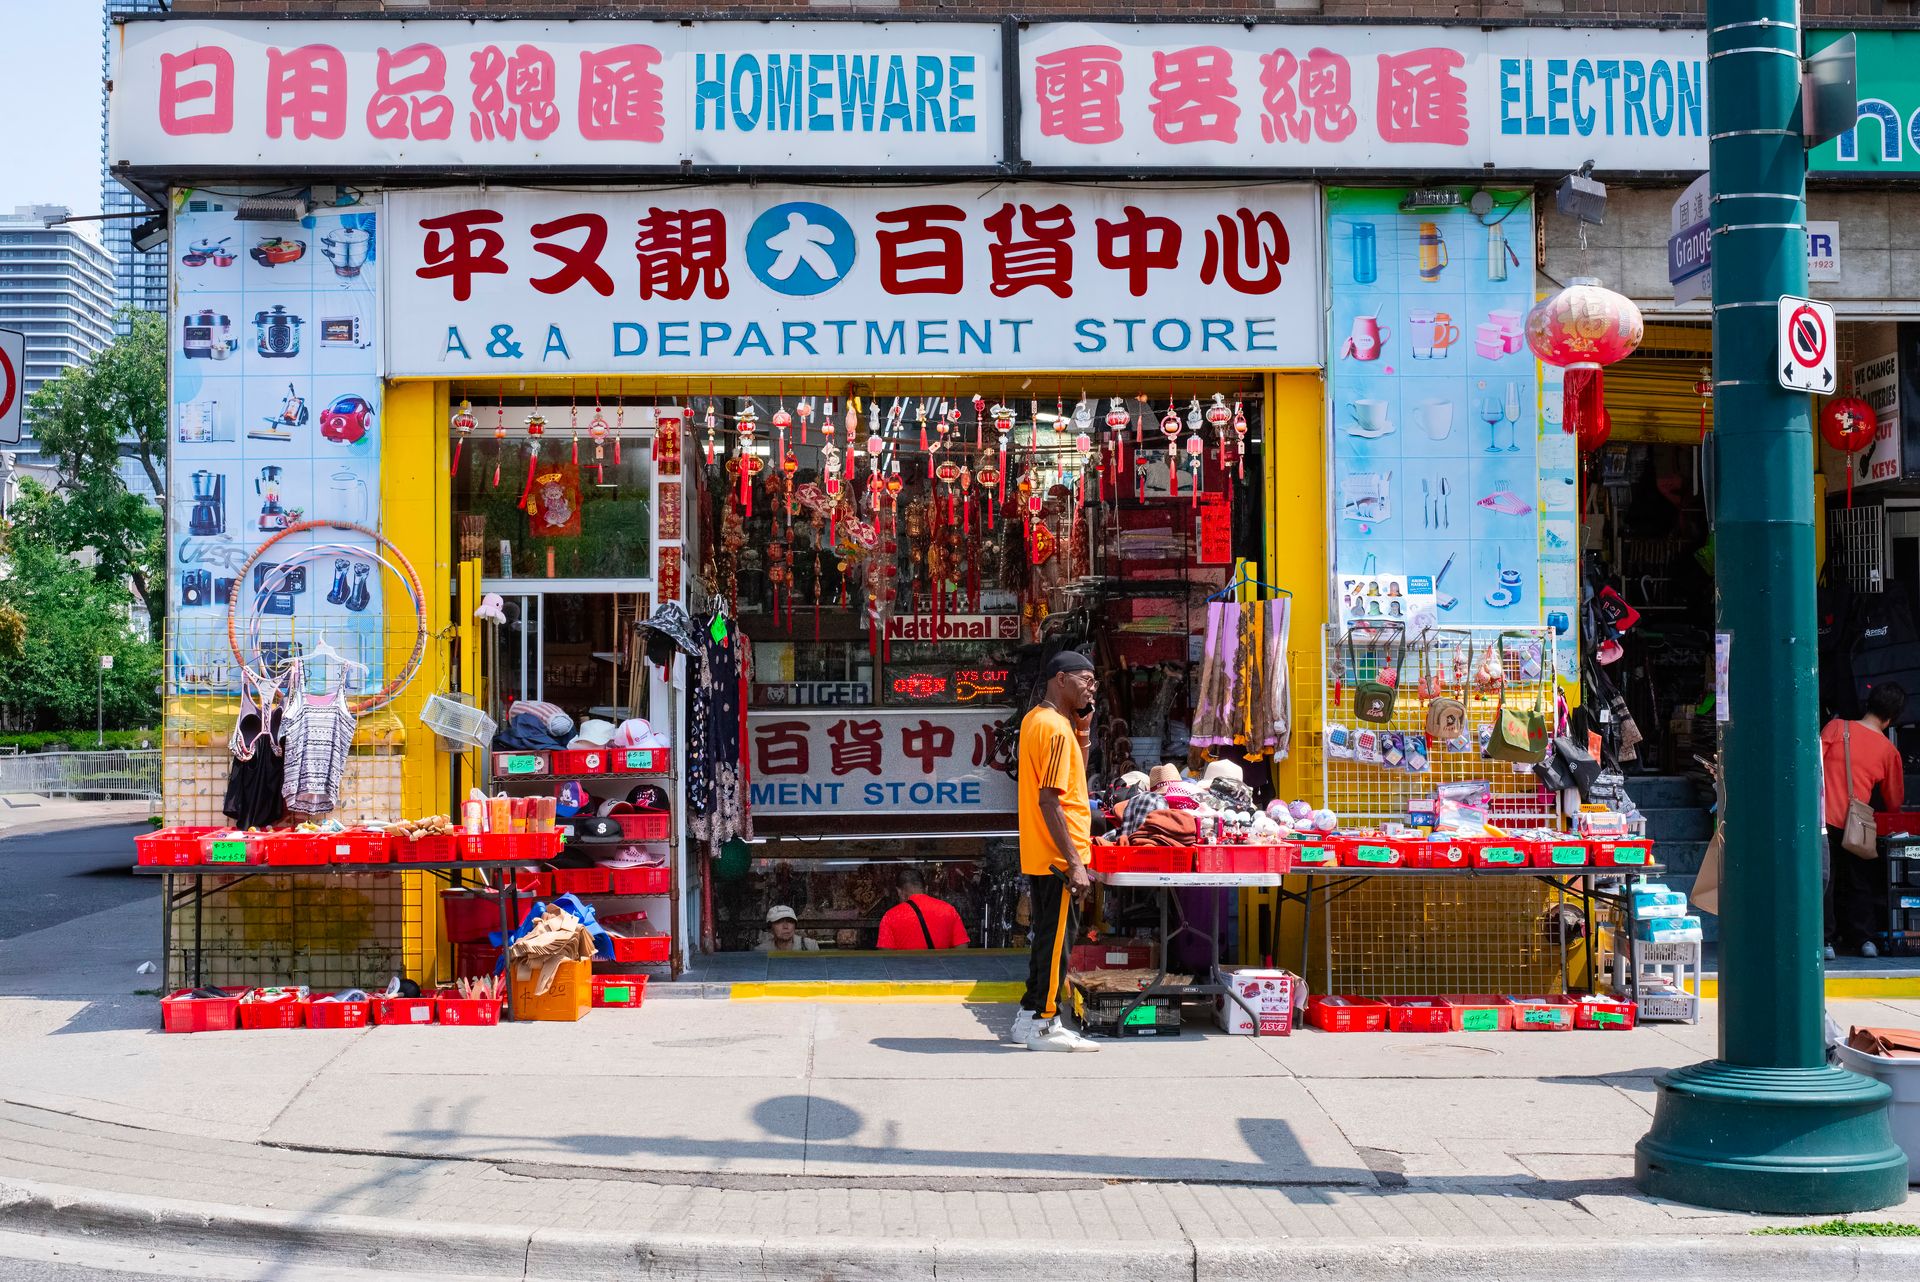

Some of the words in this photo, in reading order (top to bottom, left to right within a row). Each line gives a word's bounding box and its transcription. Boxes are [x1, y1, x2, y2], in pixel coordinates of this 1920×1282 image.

[158, 43, 665, 144] 日用品總匯
[696, 53, 975, 133] HOMEWARE
[1036, 46, 1469, 146] 電器總匯
[1500, 58, 1702, 137] ELECTRON
[1837, 97, 1920, 162] n
[416, 206, 730, 300] 平又靚
[876, 202, 1290, 299] 百貨中心
[1675, 227, 1711, 268] Grange
[1807, 234, 1832, 257] R
[1814, 261, 1834, 269] 1923
[613, 319, 1032, 357] DEPARTMENT
[1074, 317, 1278, 354] STORE
[1867, 358, 1895, 381] CHANGE
[1872, 459, 1897, 480] KEYS
[893, 679, 947, 693] OPEN
[983, 670, 1008, 681] CUT
[788, 683, 869, 705] TIGER
[863, 781, 981, 805] STORE
[1261, 1022, 1288, 1032] EASY
